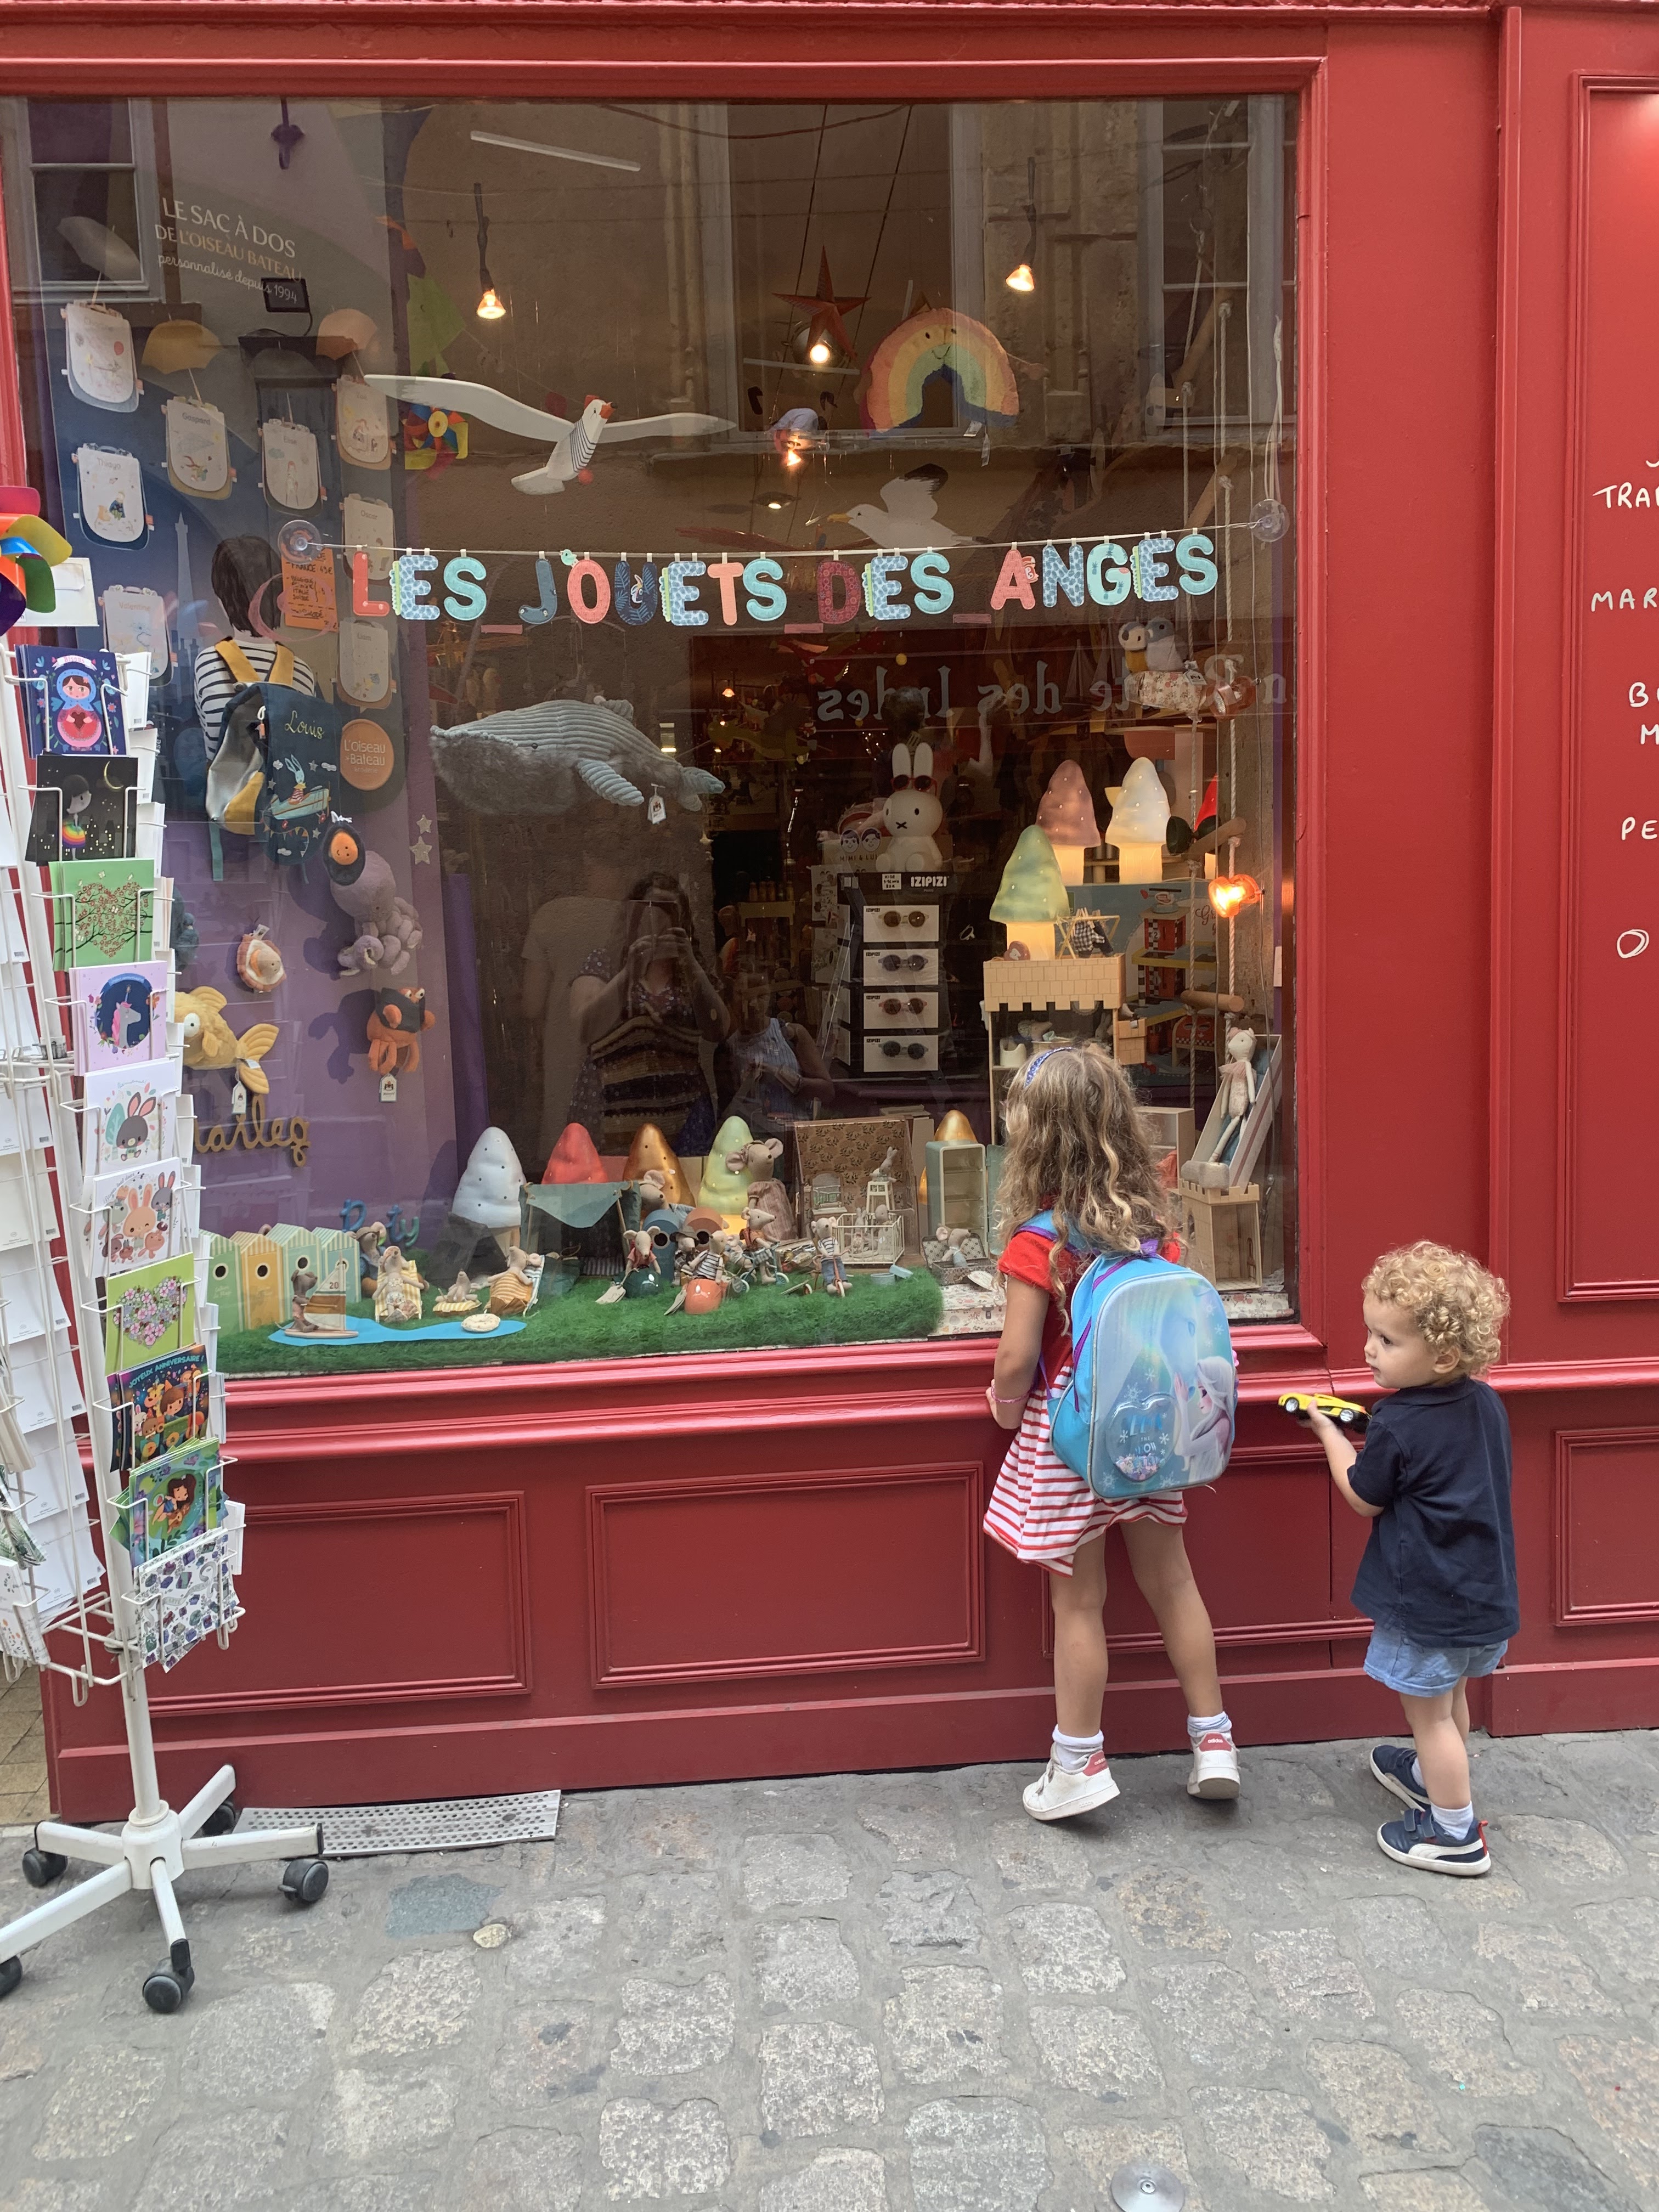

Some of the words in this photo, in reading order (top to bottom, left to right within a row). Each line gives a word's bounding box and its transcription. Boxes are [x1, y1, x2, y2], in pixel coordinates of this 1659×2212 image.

[162, 198, 188, 221] LE
[190, 205, 230, 233] SAC
[235, 215, 249, 240] À
[253, 225, 295, 258] DOS
[155, 224, 177, 242] DE
[179, 229, 244, 259] L'OISEAU
[248, 251, 302, 283] BATEAU
[158, 255, 233, 280] personnalisé
[235, 270, 272, 294] depuis
[274, 284, 297, 304] 1994
[182, 412, 211, 427] Gaspard
[360, 510, 377, 520] Oscar
[353, 551, 488, 620] LES
[518, 558, 787, 625] JOUETS
[816, 552, 954, 625] DES
[990, 534, 1218, 610] ANGES
[1628, 682, 1659, 707] B
[285, 710, 325, 740] Louis
[344, 740, 386, 754] L'Oiseau
[350, 753, 386, 766] Bateau
[911, 876, 947, 887] IZIPIZI
[128, 1368, 154, 1389] JOYEUX
[155, 1355, 200, 1372] ANNIVERSAIRE
